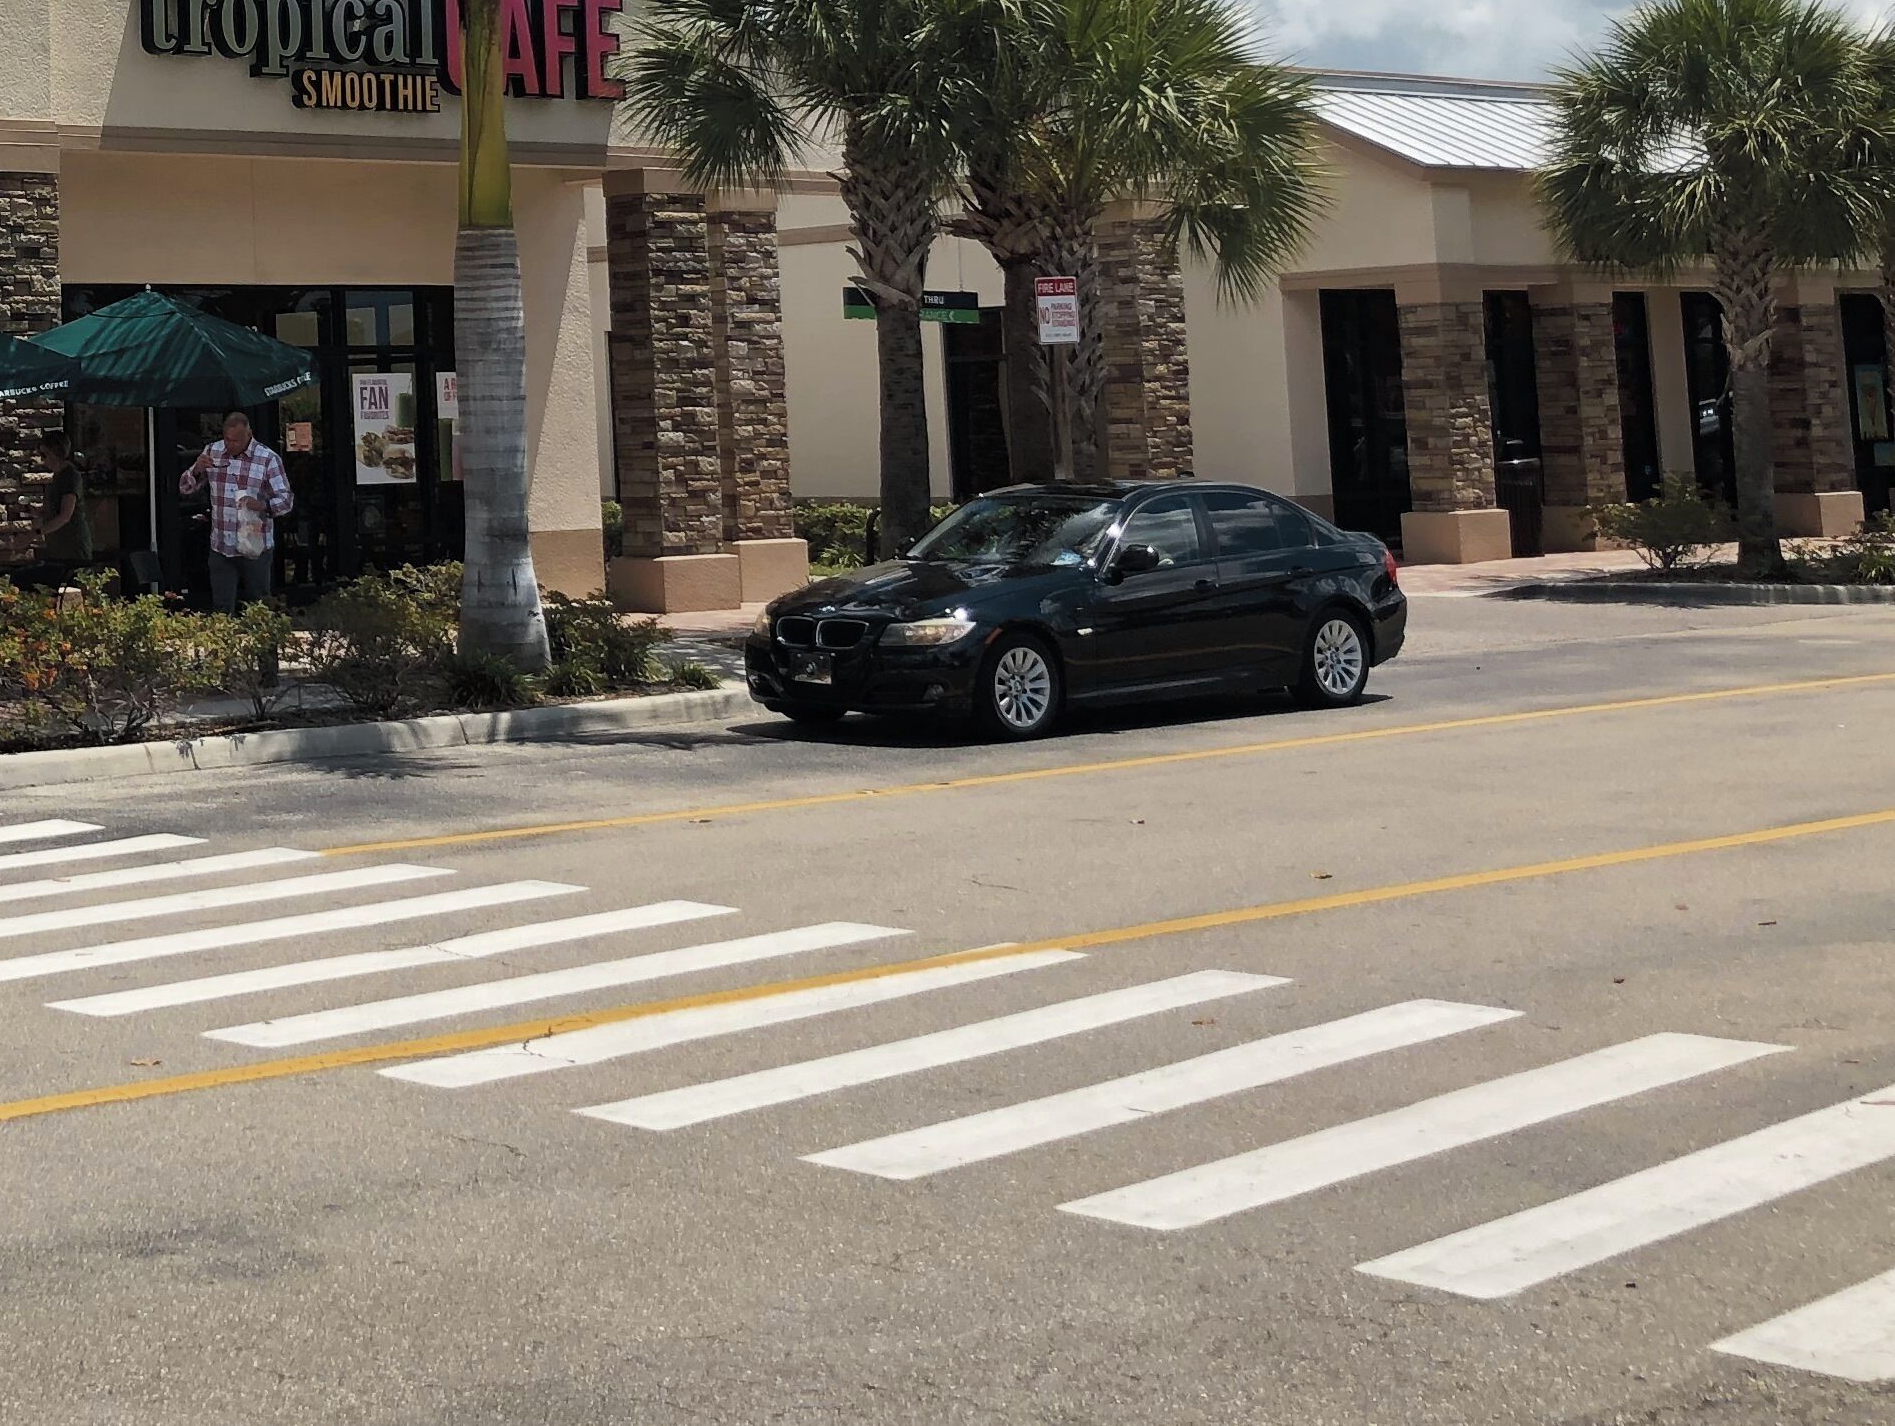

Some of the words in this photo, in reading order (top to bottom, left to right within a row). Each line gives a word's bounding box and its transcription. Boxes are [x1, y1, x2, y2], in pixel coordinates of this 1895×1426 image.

[296, 68, 440, 112] SMOOTHIE
[1037, 282, 1054, 294] FIRE
[1055, 282, 1074, 293] LANE
[923, 294, 945, 304] THRU
[1039, 306, 1050, 325] NO
[359, 386, 389, 410] FAN
